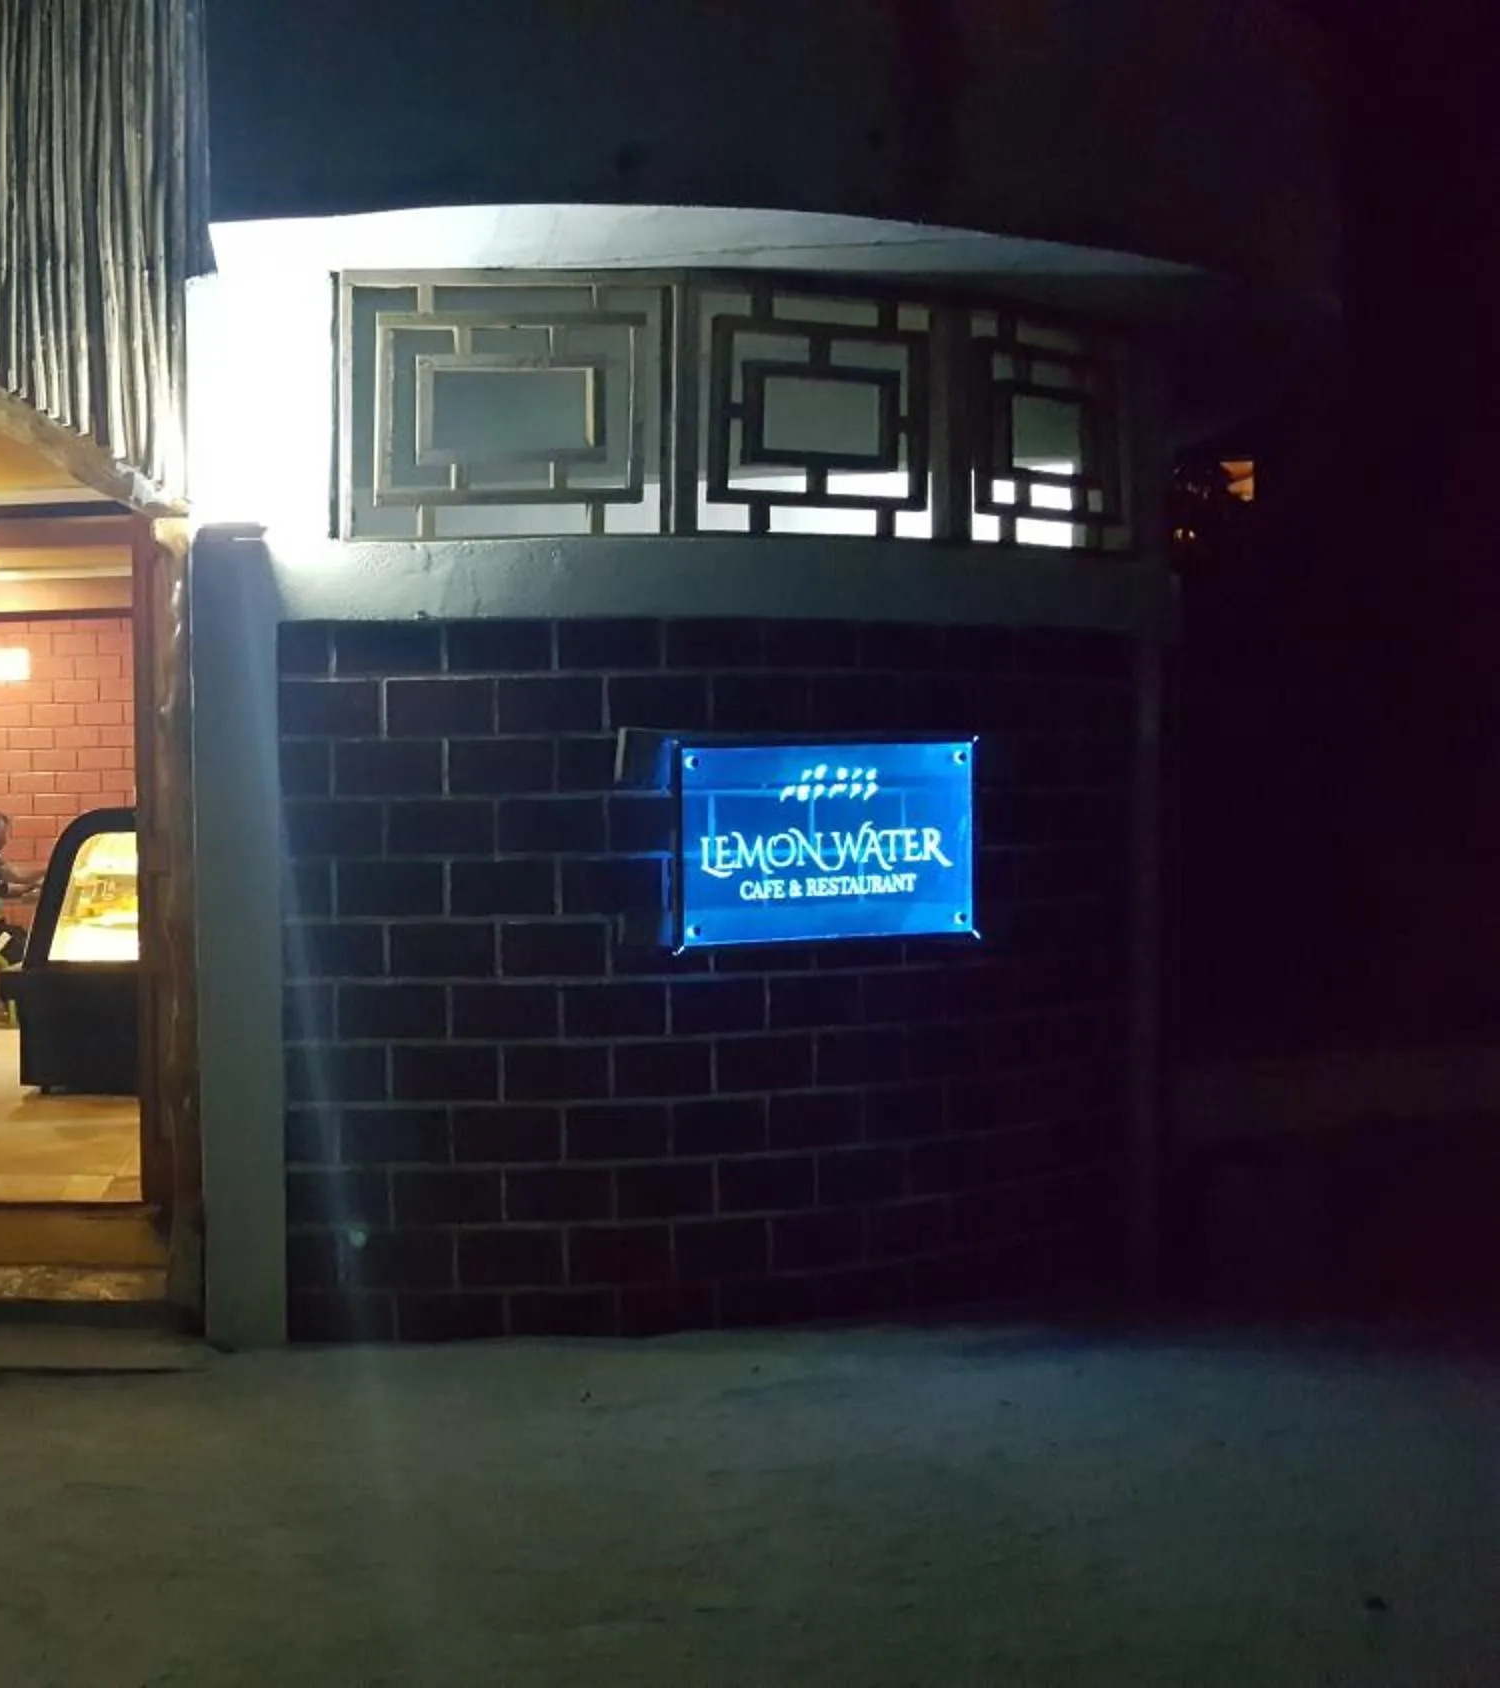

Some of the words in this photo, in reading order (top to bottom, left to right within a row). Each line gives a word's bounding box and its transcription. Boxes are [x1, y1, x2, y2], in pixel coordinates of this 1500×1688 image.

[700, 828, 832, 878] LEMON
[828, 821, 954, 871] WATER
[739, 879, 785, 901] CAFE
[788, 880, 804, 898] &
[806, 873, 917, 897] RESTAURANT
